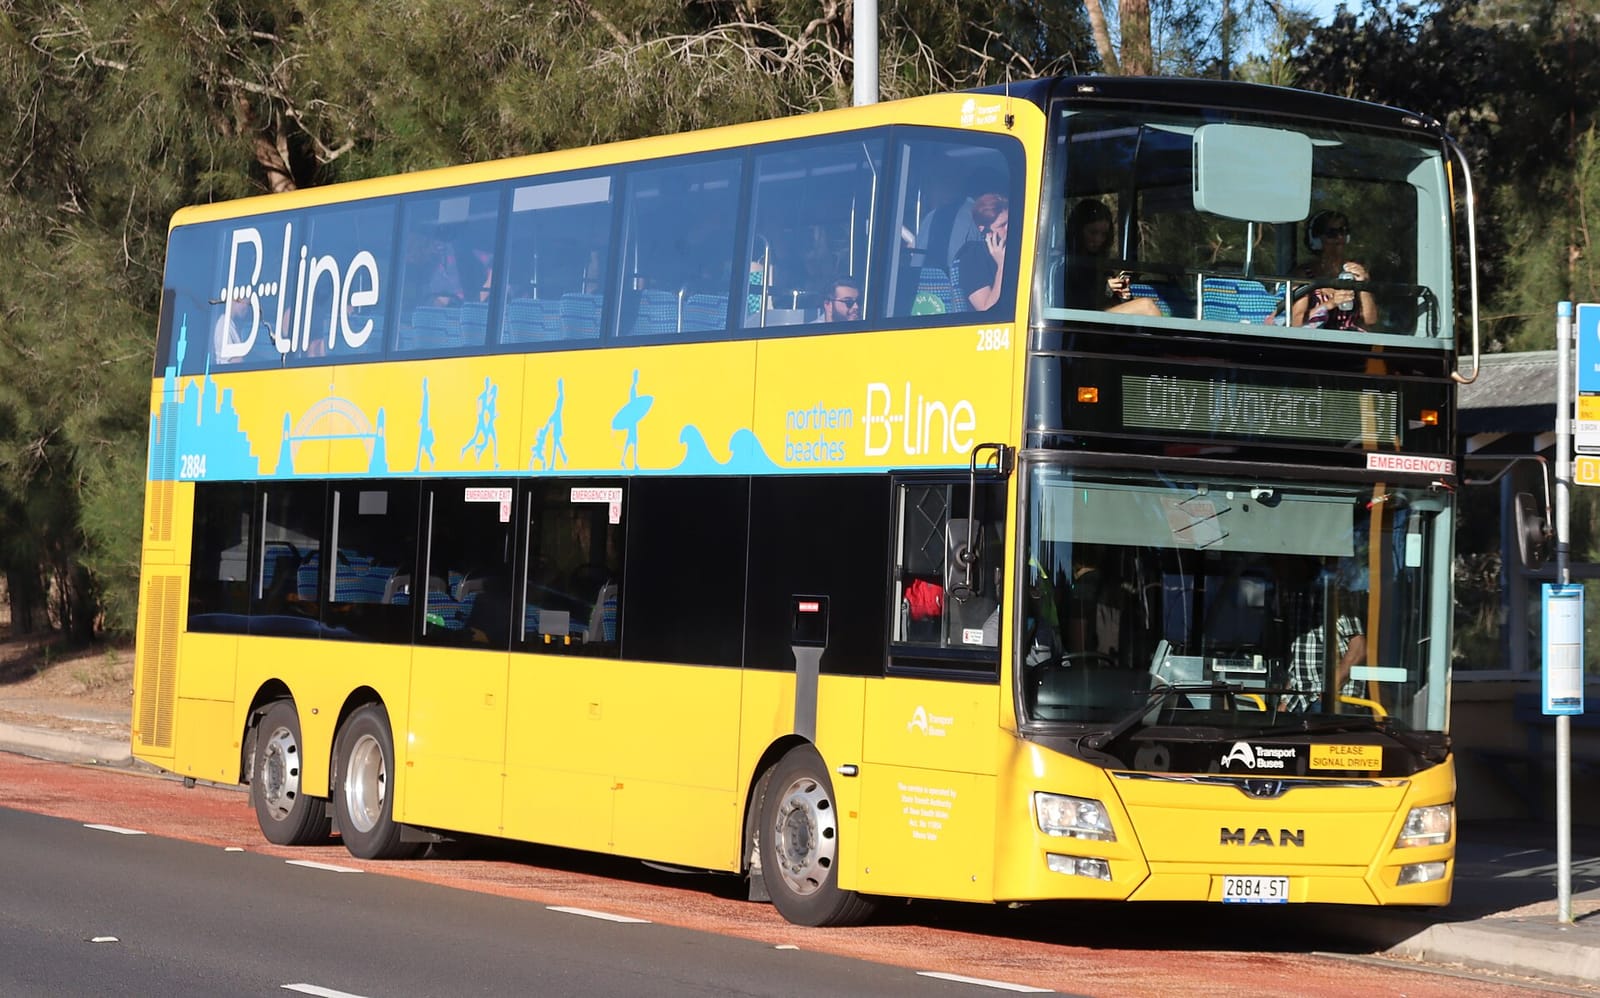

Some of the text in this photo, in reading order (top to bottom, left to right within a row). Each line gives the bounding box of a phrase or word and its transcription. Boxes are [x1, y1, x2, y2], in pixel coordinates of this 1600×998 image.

[976, 328, 1010, 351] 2884
[1146, 375, 1198, 430] City
[786, 401, 853, 430] northern
[785, 434, 845, 462] beaches
[180, 454, 207, 478] 2884
[1370, 456, 1443, 472] EMERGENCY
[466, 490, 511, 500] EMERGENCY EXIT
[572, 490, 621, 500] EMERGENCY EXIT
[1255, 747, 1296, 759] Transport
[1329, 745, 1363, 755] PLEASE
[1256, 758, 1284, 769] Buses
[1313, 758, 1379, 768] SIGNAL DRIVER
[1220, 827, 1305, 847] MAN
